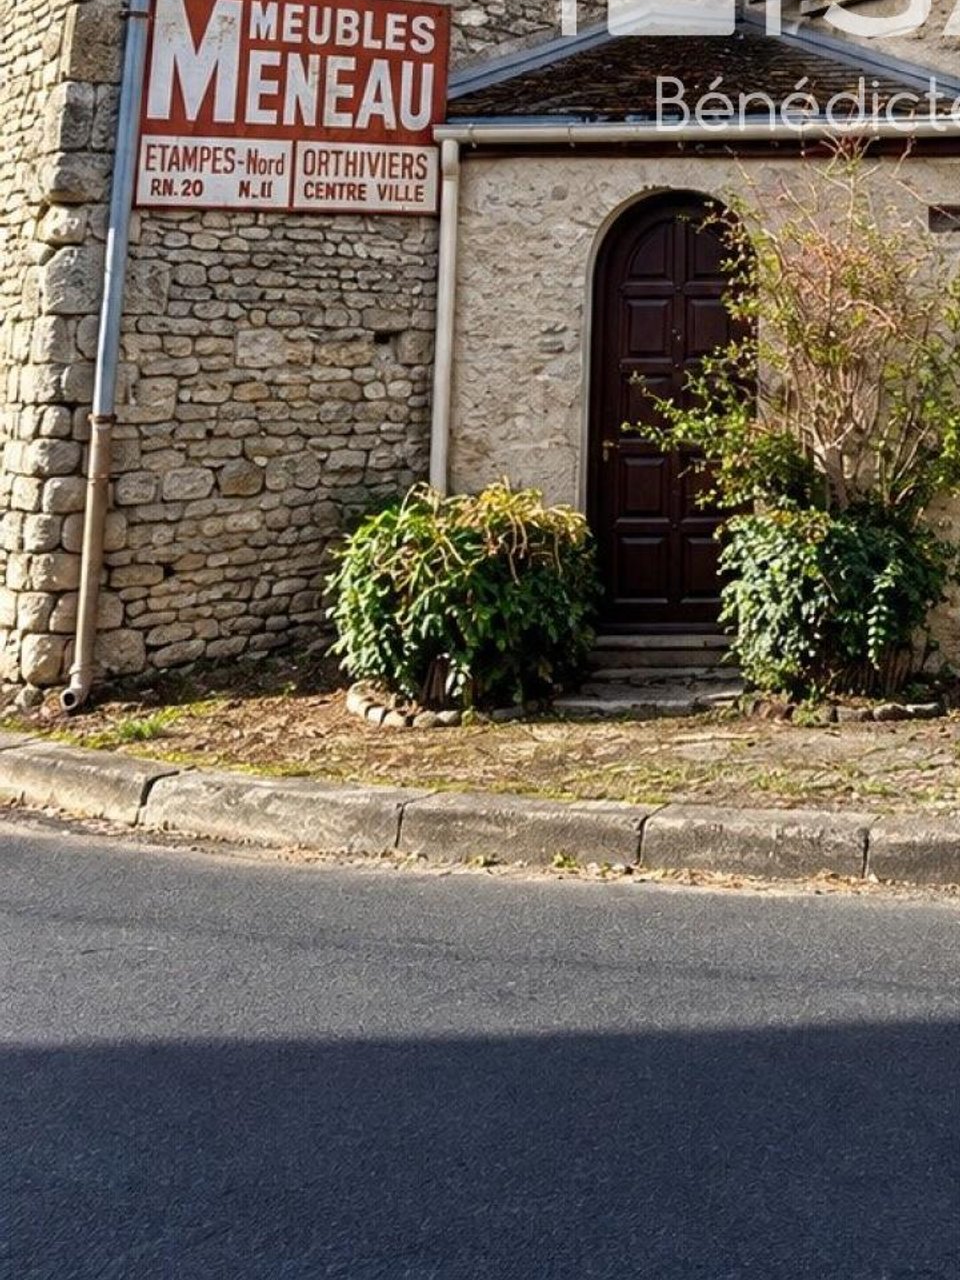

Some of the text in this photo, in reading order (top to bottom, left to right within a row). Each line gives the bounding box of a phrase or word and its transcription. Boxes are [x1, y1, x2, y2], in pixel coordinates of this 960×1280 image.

[250, 0, 436, 54] MEUBLES
[303, 148, 428, 180] ORTHIVIERS
[303, 180, 425, 203] CENTRE VILLE
